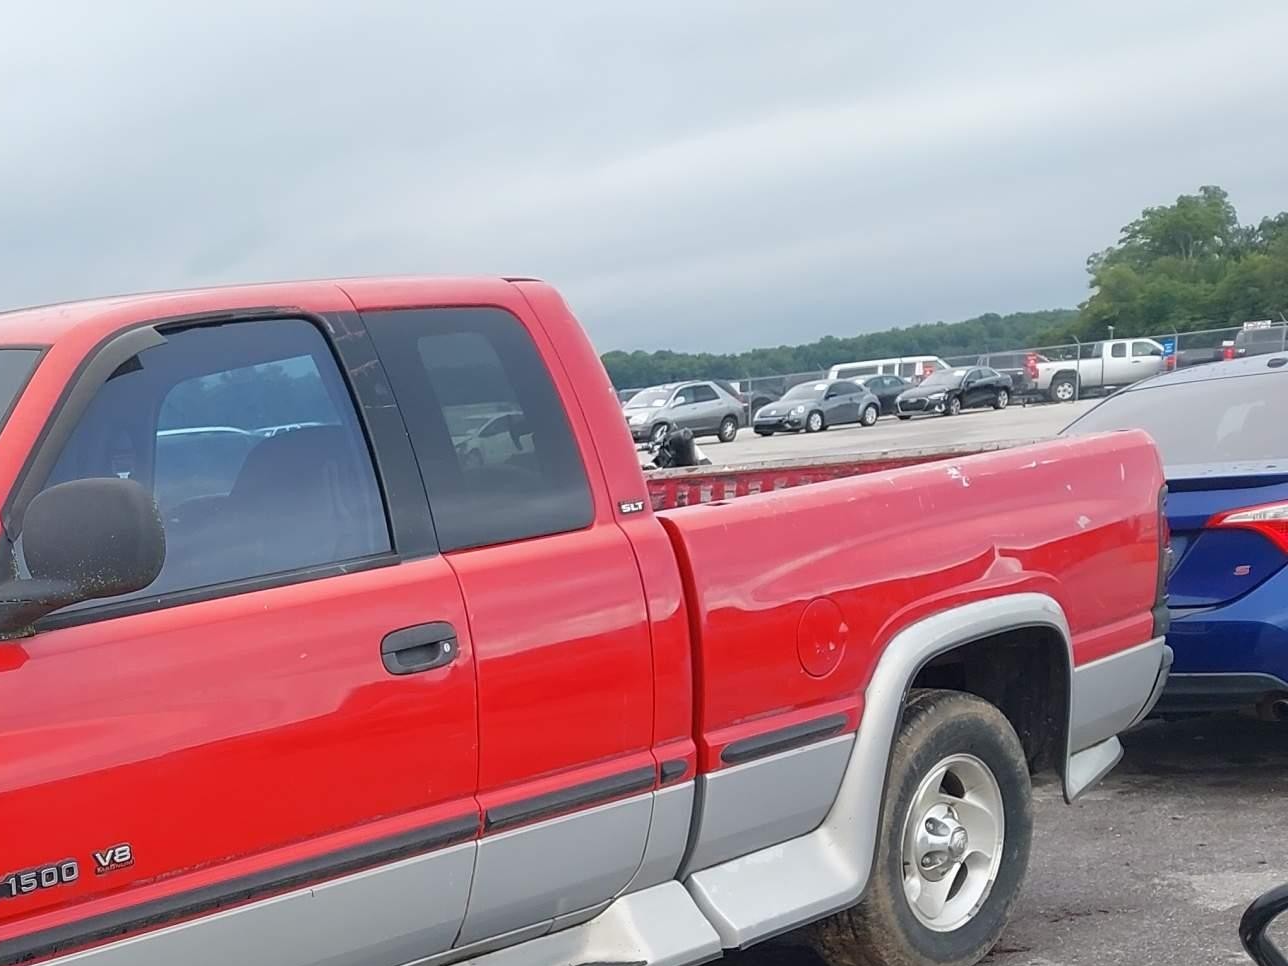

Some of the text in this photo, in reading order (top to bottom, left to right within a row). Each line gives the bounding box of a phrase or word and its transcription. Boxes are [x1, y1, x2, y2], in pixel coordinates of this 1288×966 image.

[620, 501, 644, 513] SLT
[7, 861, 79, 896] 1500
[95, 845, 131, 866] V8
